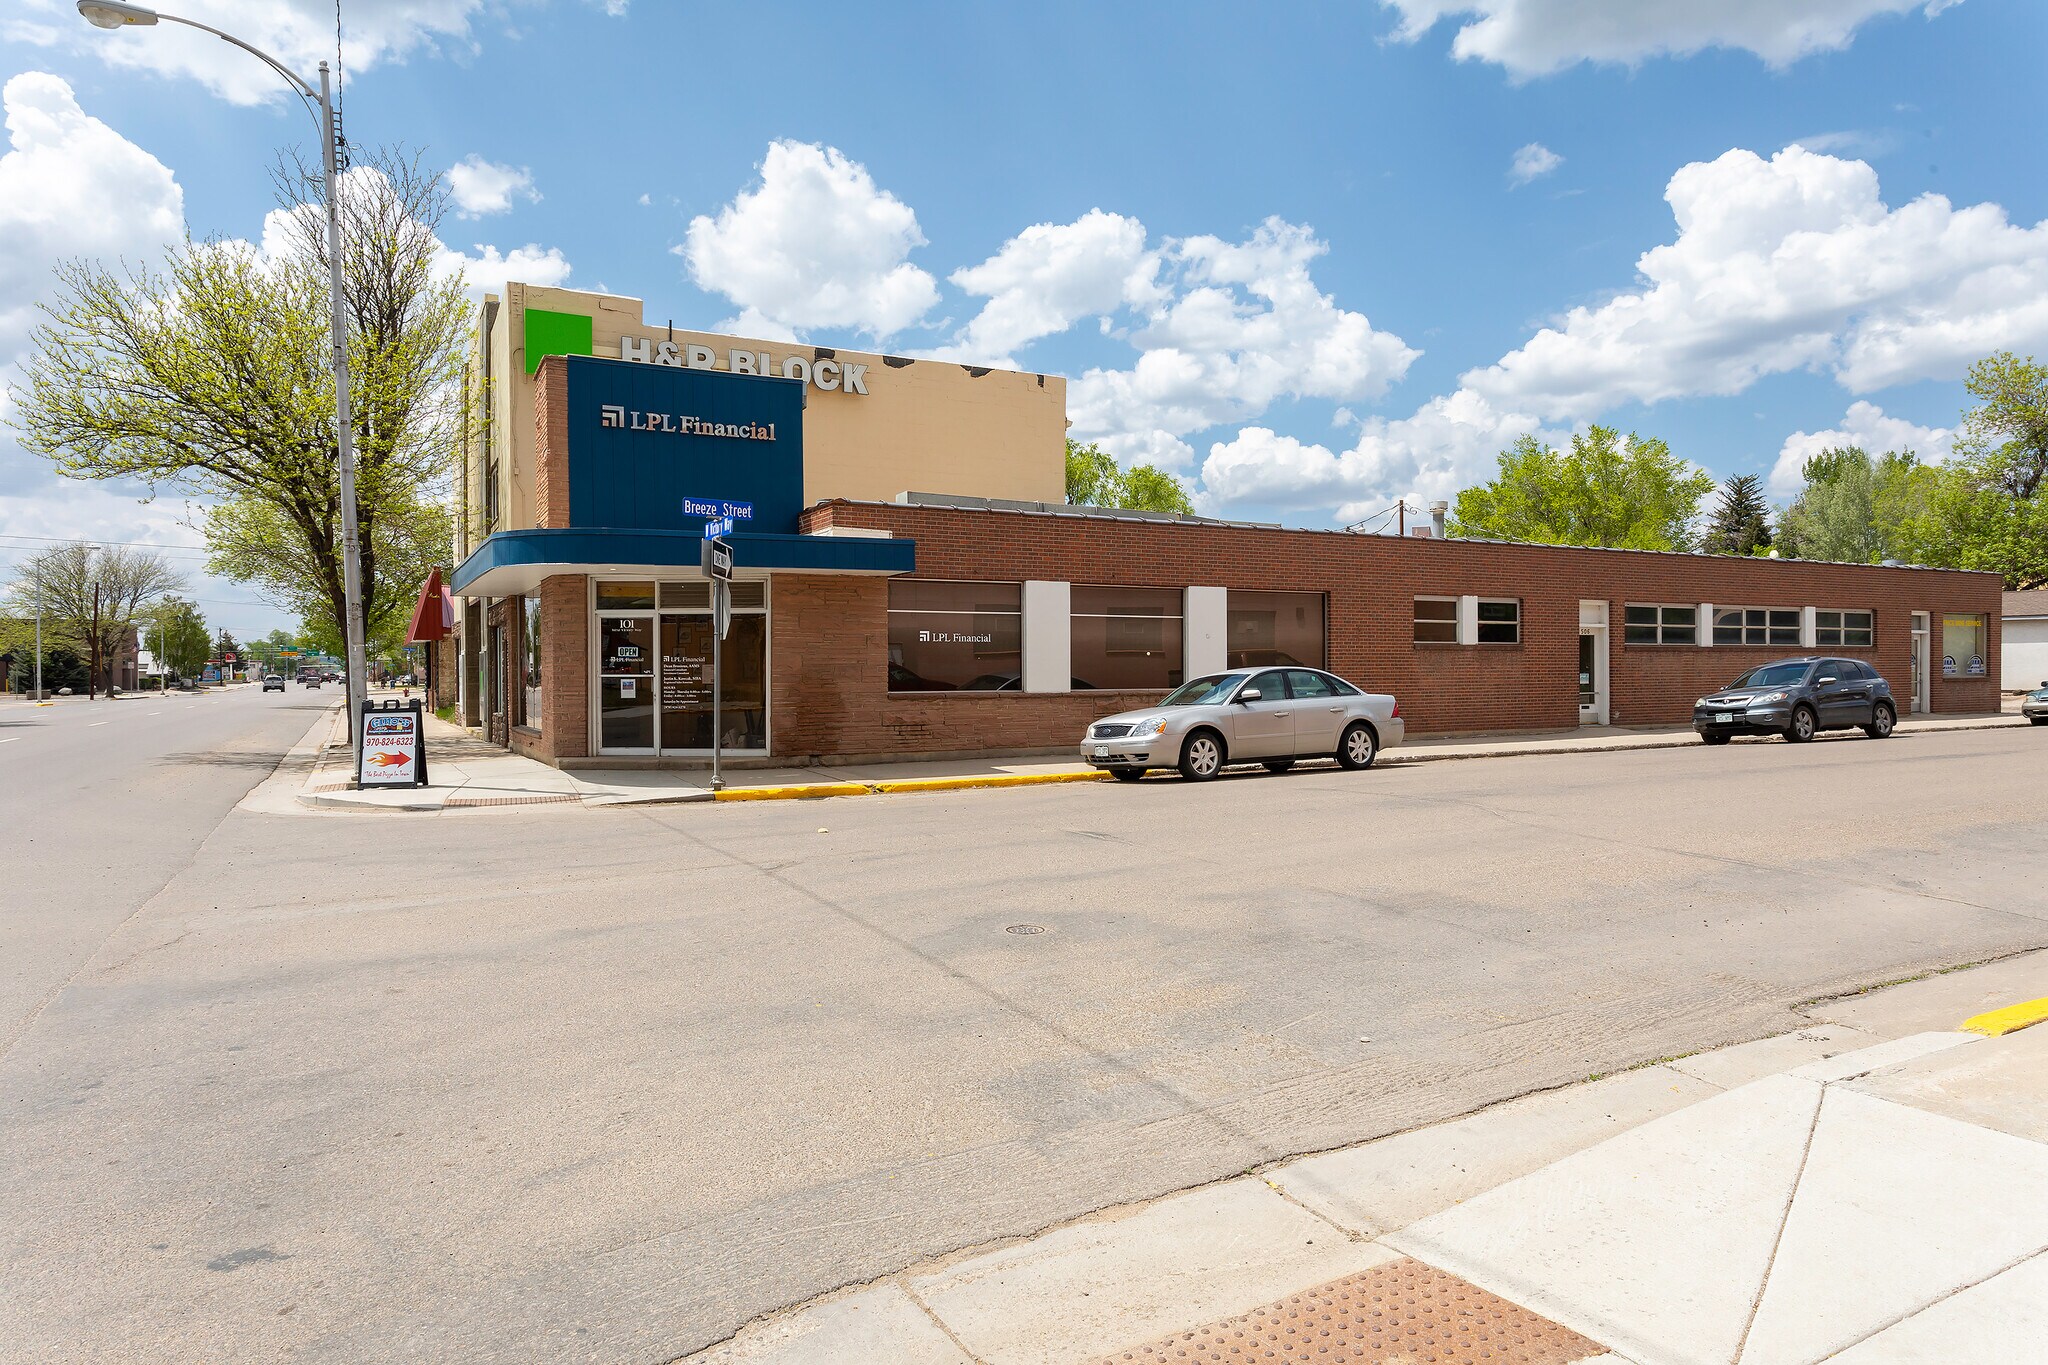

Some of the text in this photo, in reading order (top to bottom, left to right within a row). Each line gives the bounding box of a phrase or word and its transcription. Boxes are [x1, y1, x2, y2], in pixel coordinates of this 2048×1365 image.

[621, 335, 869, 395] H&R BLOCK
[630, 411, 777, 441] LPL Financial
[684, 499, 752, 518] Breeze Street
[932, 632, 991, 643] LPL Financial
[619, 647, 638, 656] OPEN
[366, 737, 413, 746] 970-824-6323
